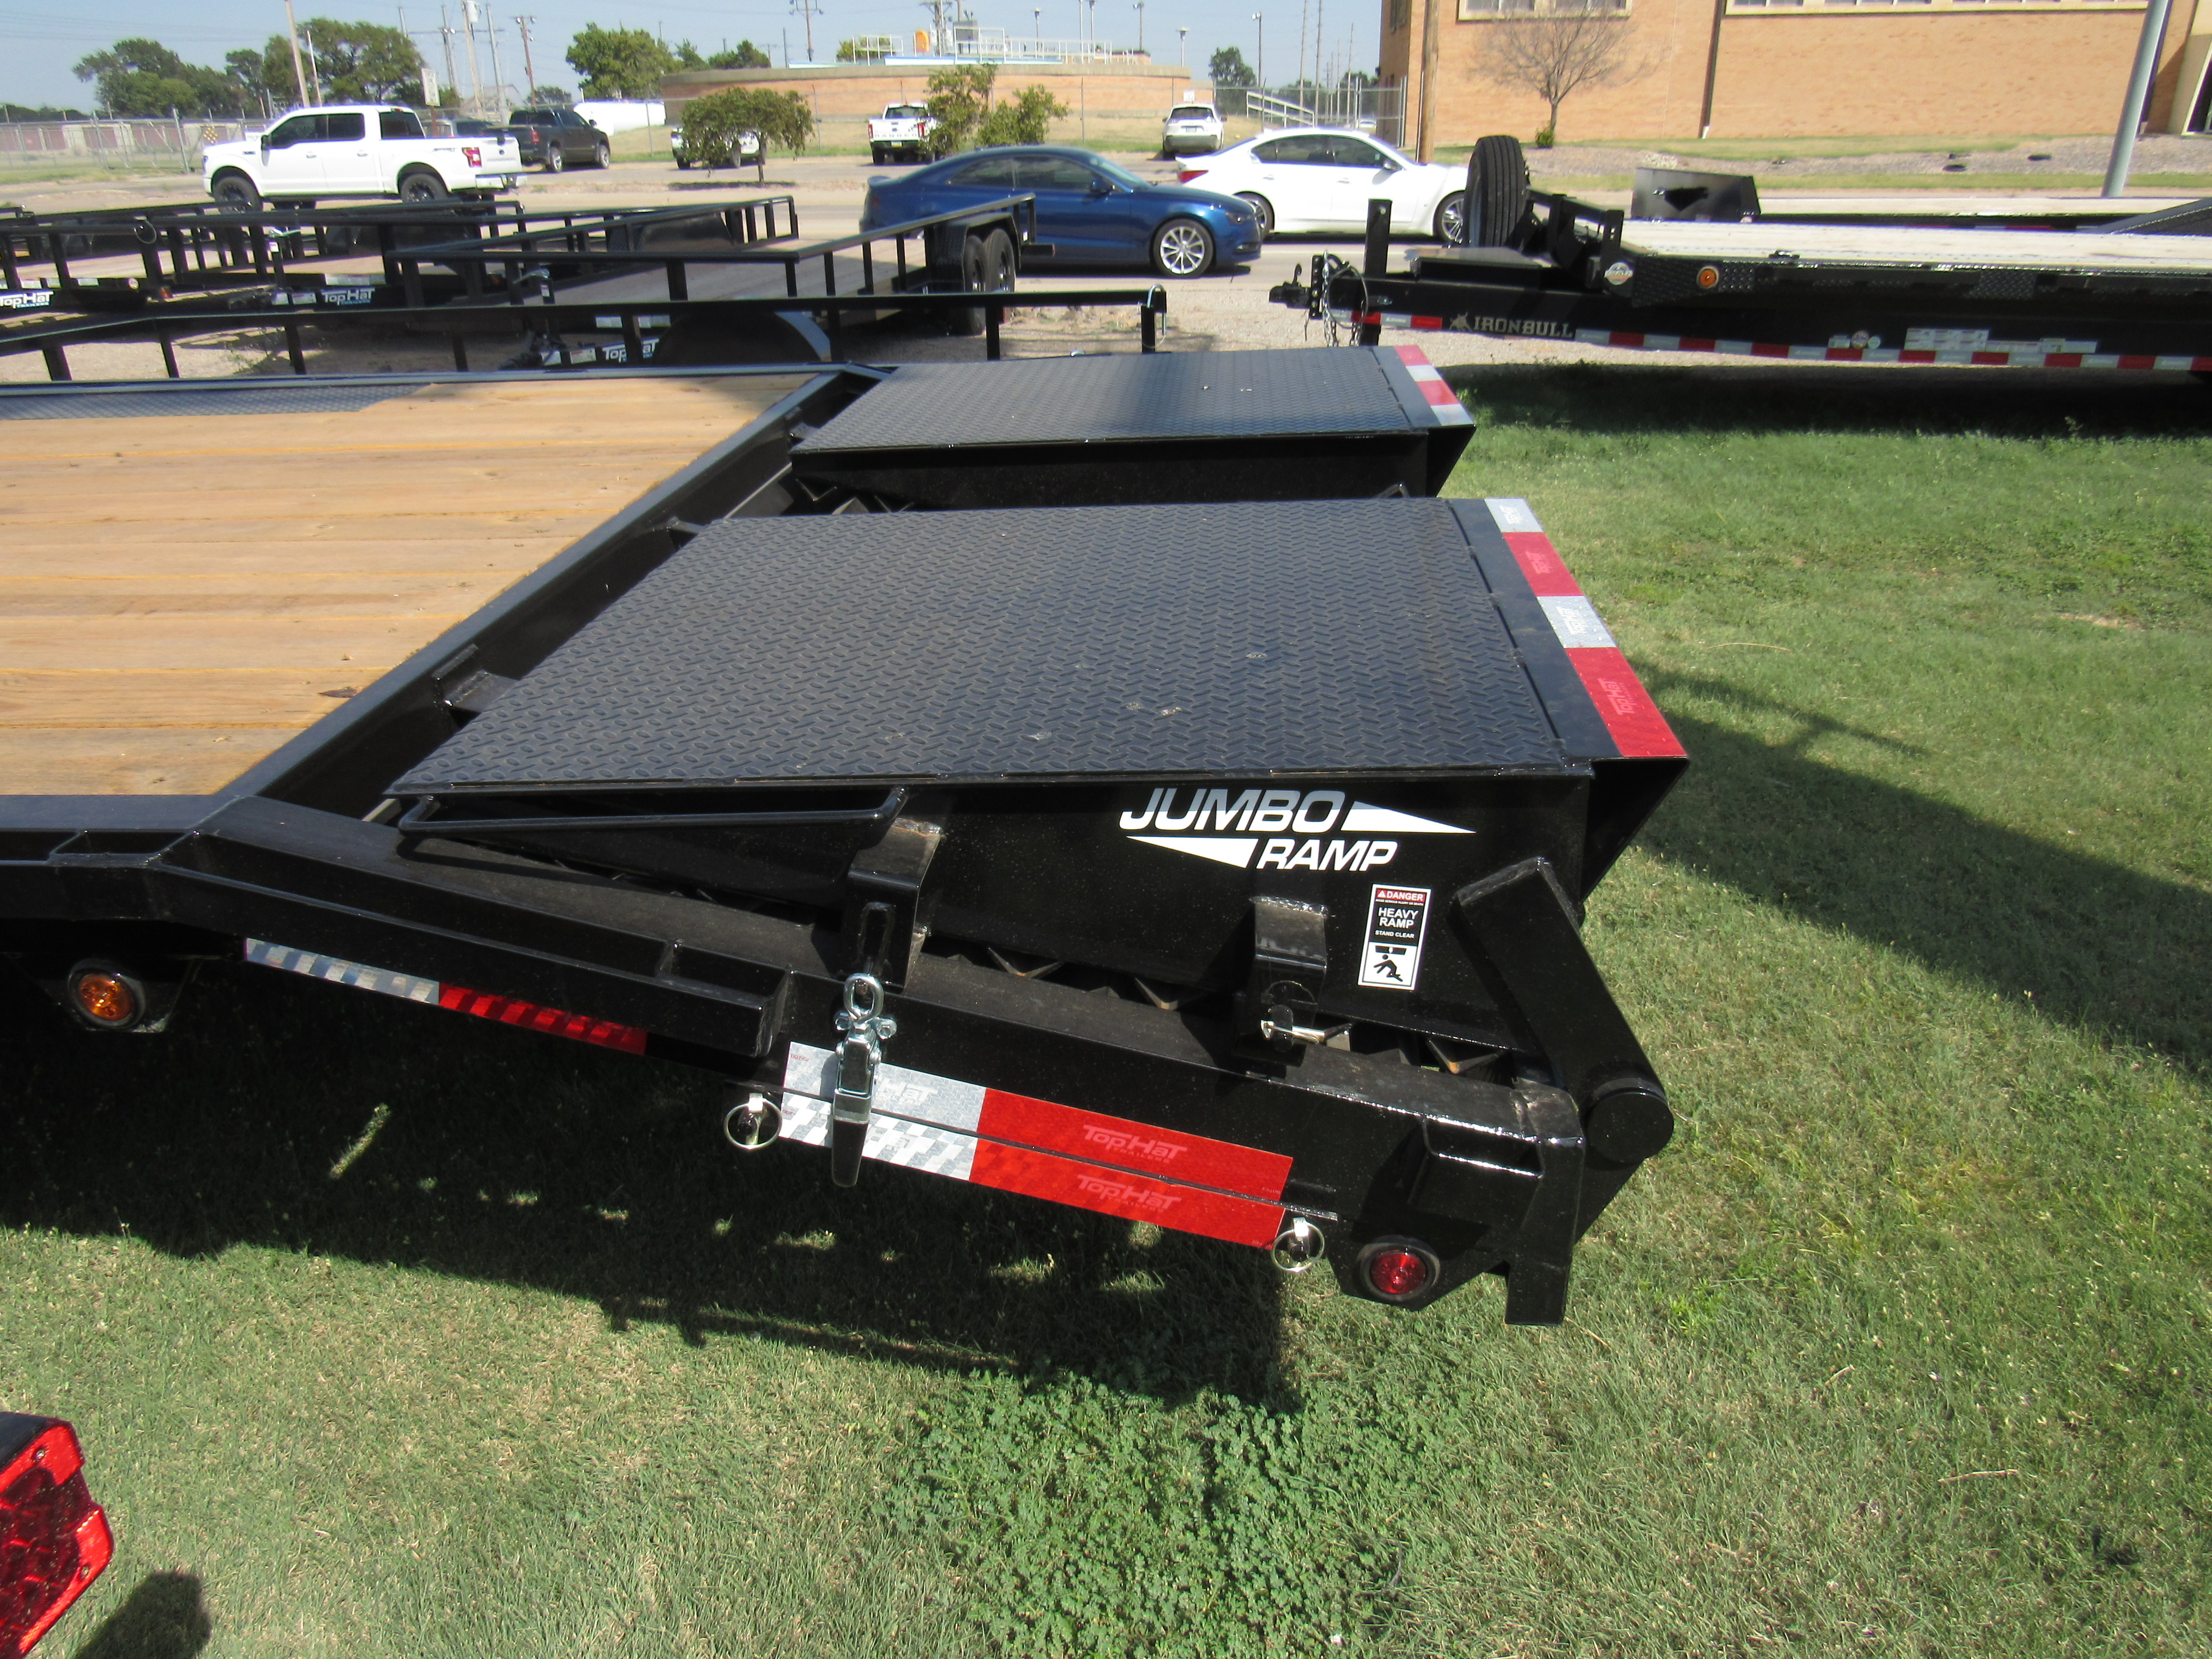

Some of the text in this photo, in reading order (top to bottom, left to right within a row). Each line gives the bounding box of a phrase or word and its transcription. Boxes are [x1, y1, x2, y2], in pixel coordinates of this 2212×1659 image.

[1119, 788, 1346, 833] JUMBO
[1256, 838, 1398, 872] RAMP
[1386, 890, 1423, 901] DANGER
[1378, 907, 1419, 920] HEAVY
[1379, 917, 1414, 929] RAMP
[1114, 1146, 1170, 1164] TRAILERS
